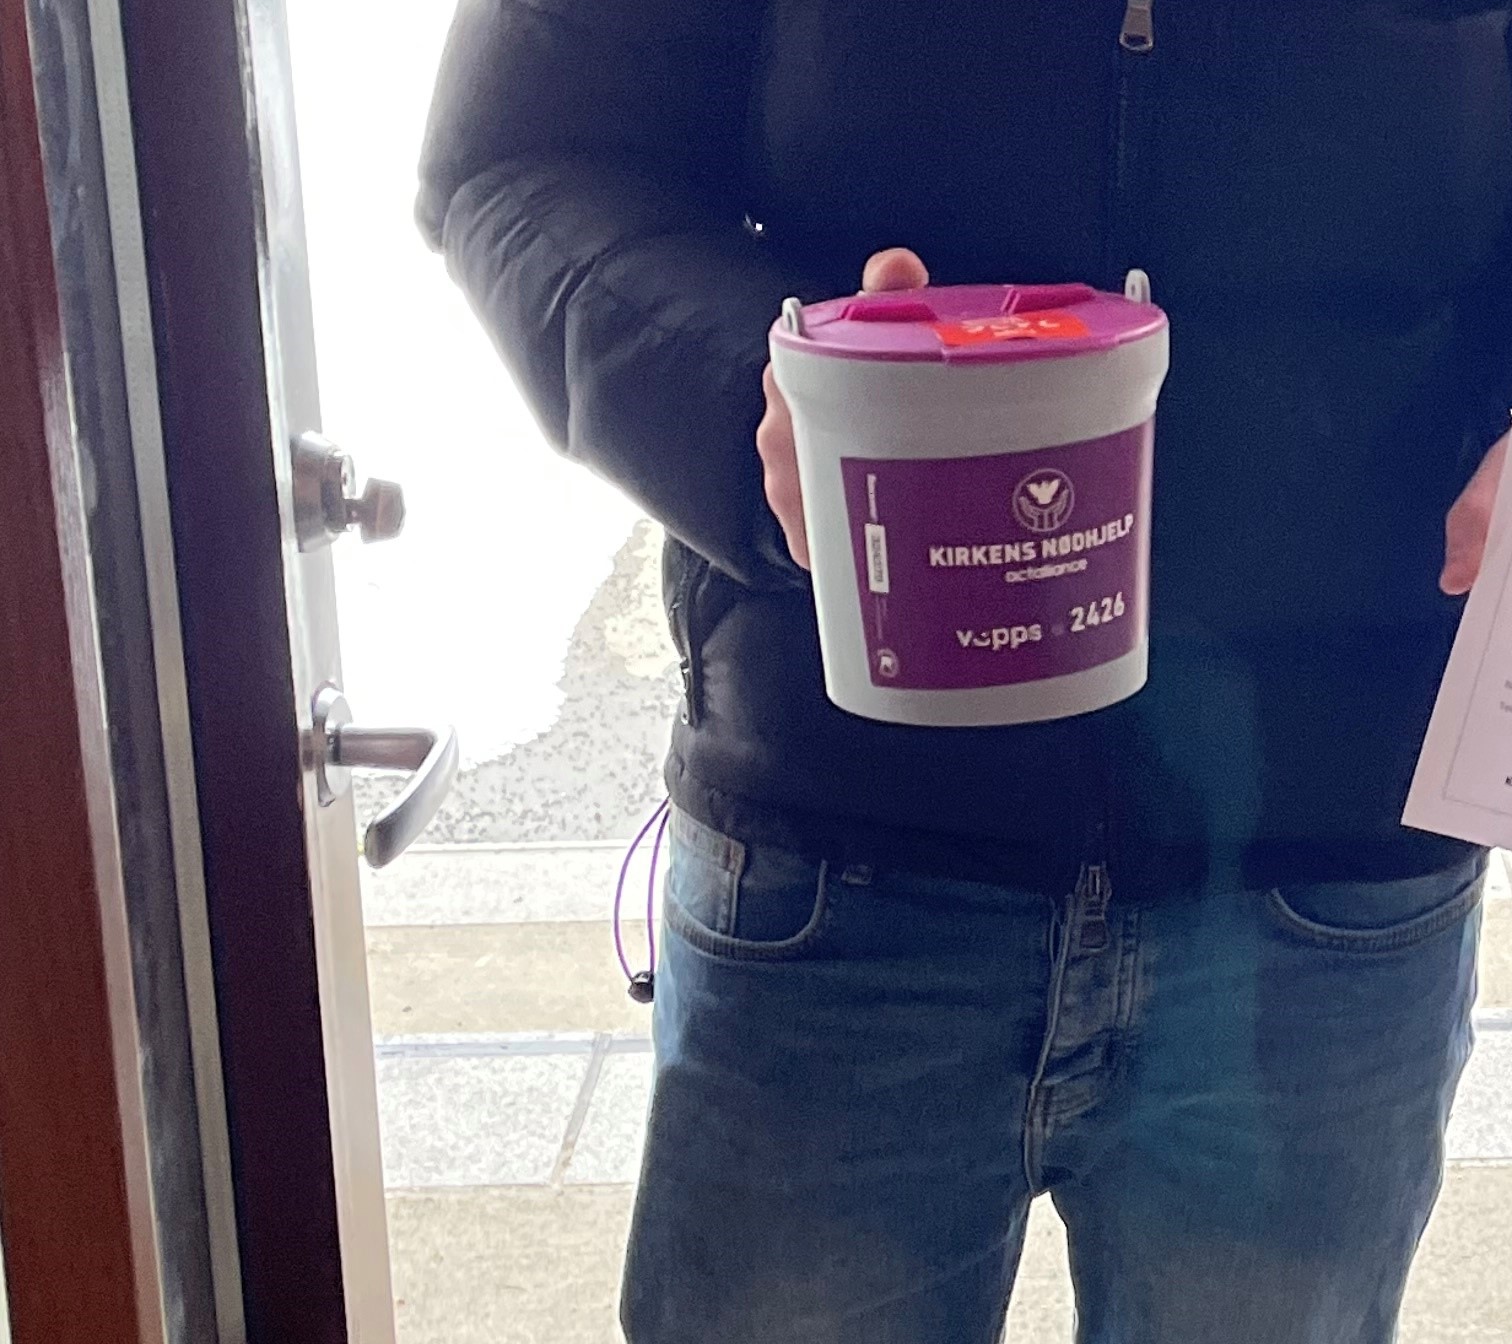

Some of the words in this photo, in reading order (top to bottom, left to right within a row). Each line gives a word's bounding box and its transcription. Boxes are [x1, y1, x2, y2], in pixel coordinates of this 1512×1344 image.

[929, 542, 1036, 566] KIRKENS
[1042, 513, 1134, 558] NØDHJELP
[1070, 591, 1125, 632] 2426
